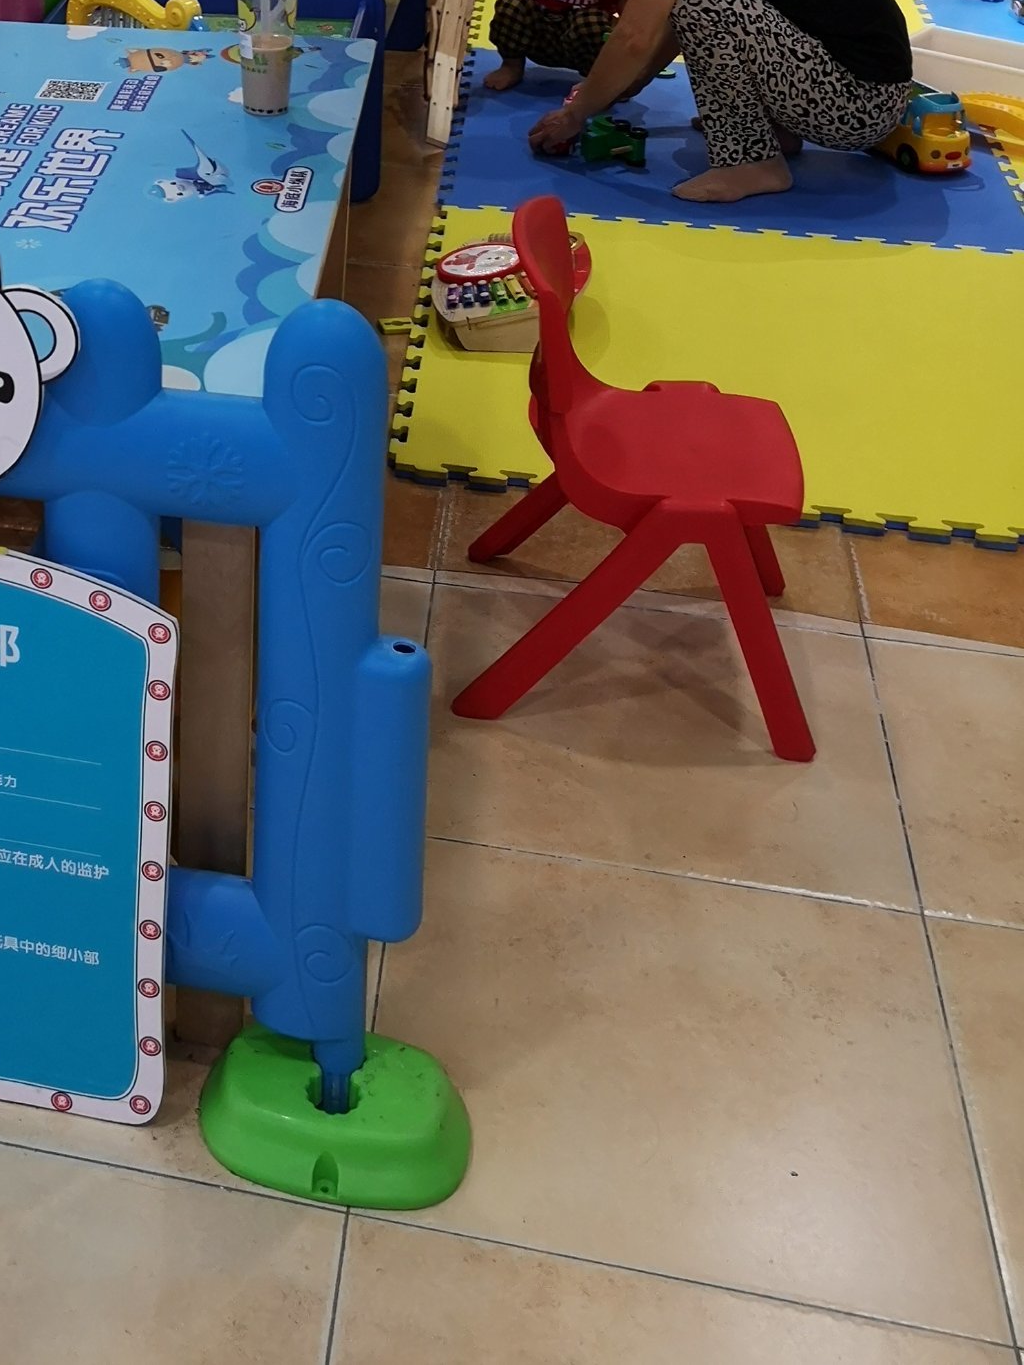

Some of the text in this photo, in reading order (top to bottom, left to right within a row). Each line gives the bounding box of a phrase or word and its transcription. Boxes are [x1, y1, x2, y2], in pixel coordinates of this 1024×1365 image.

[15, 103, 63, 147] FOR KIDS
[0, 128, 126, 233] 欢乐世界
